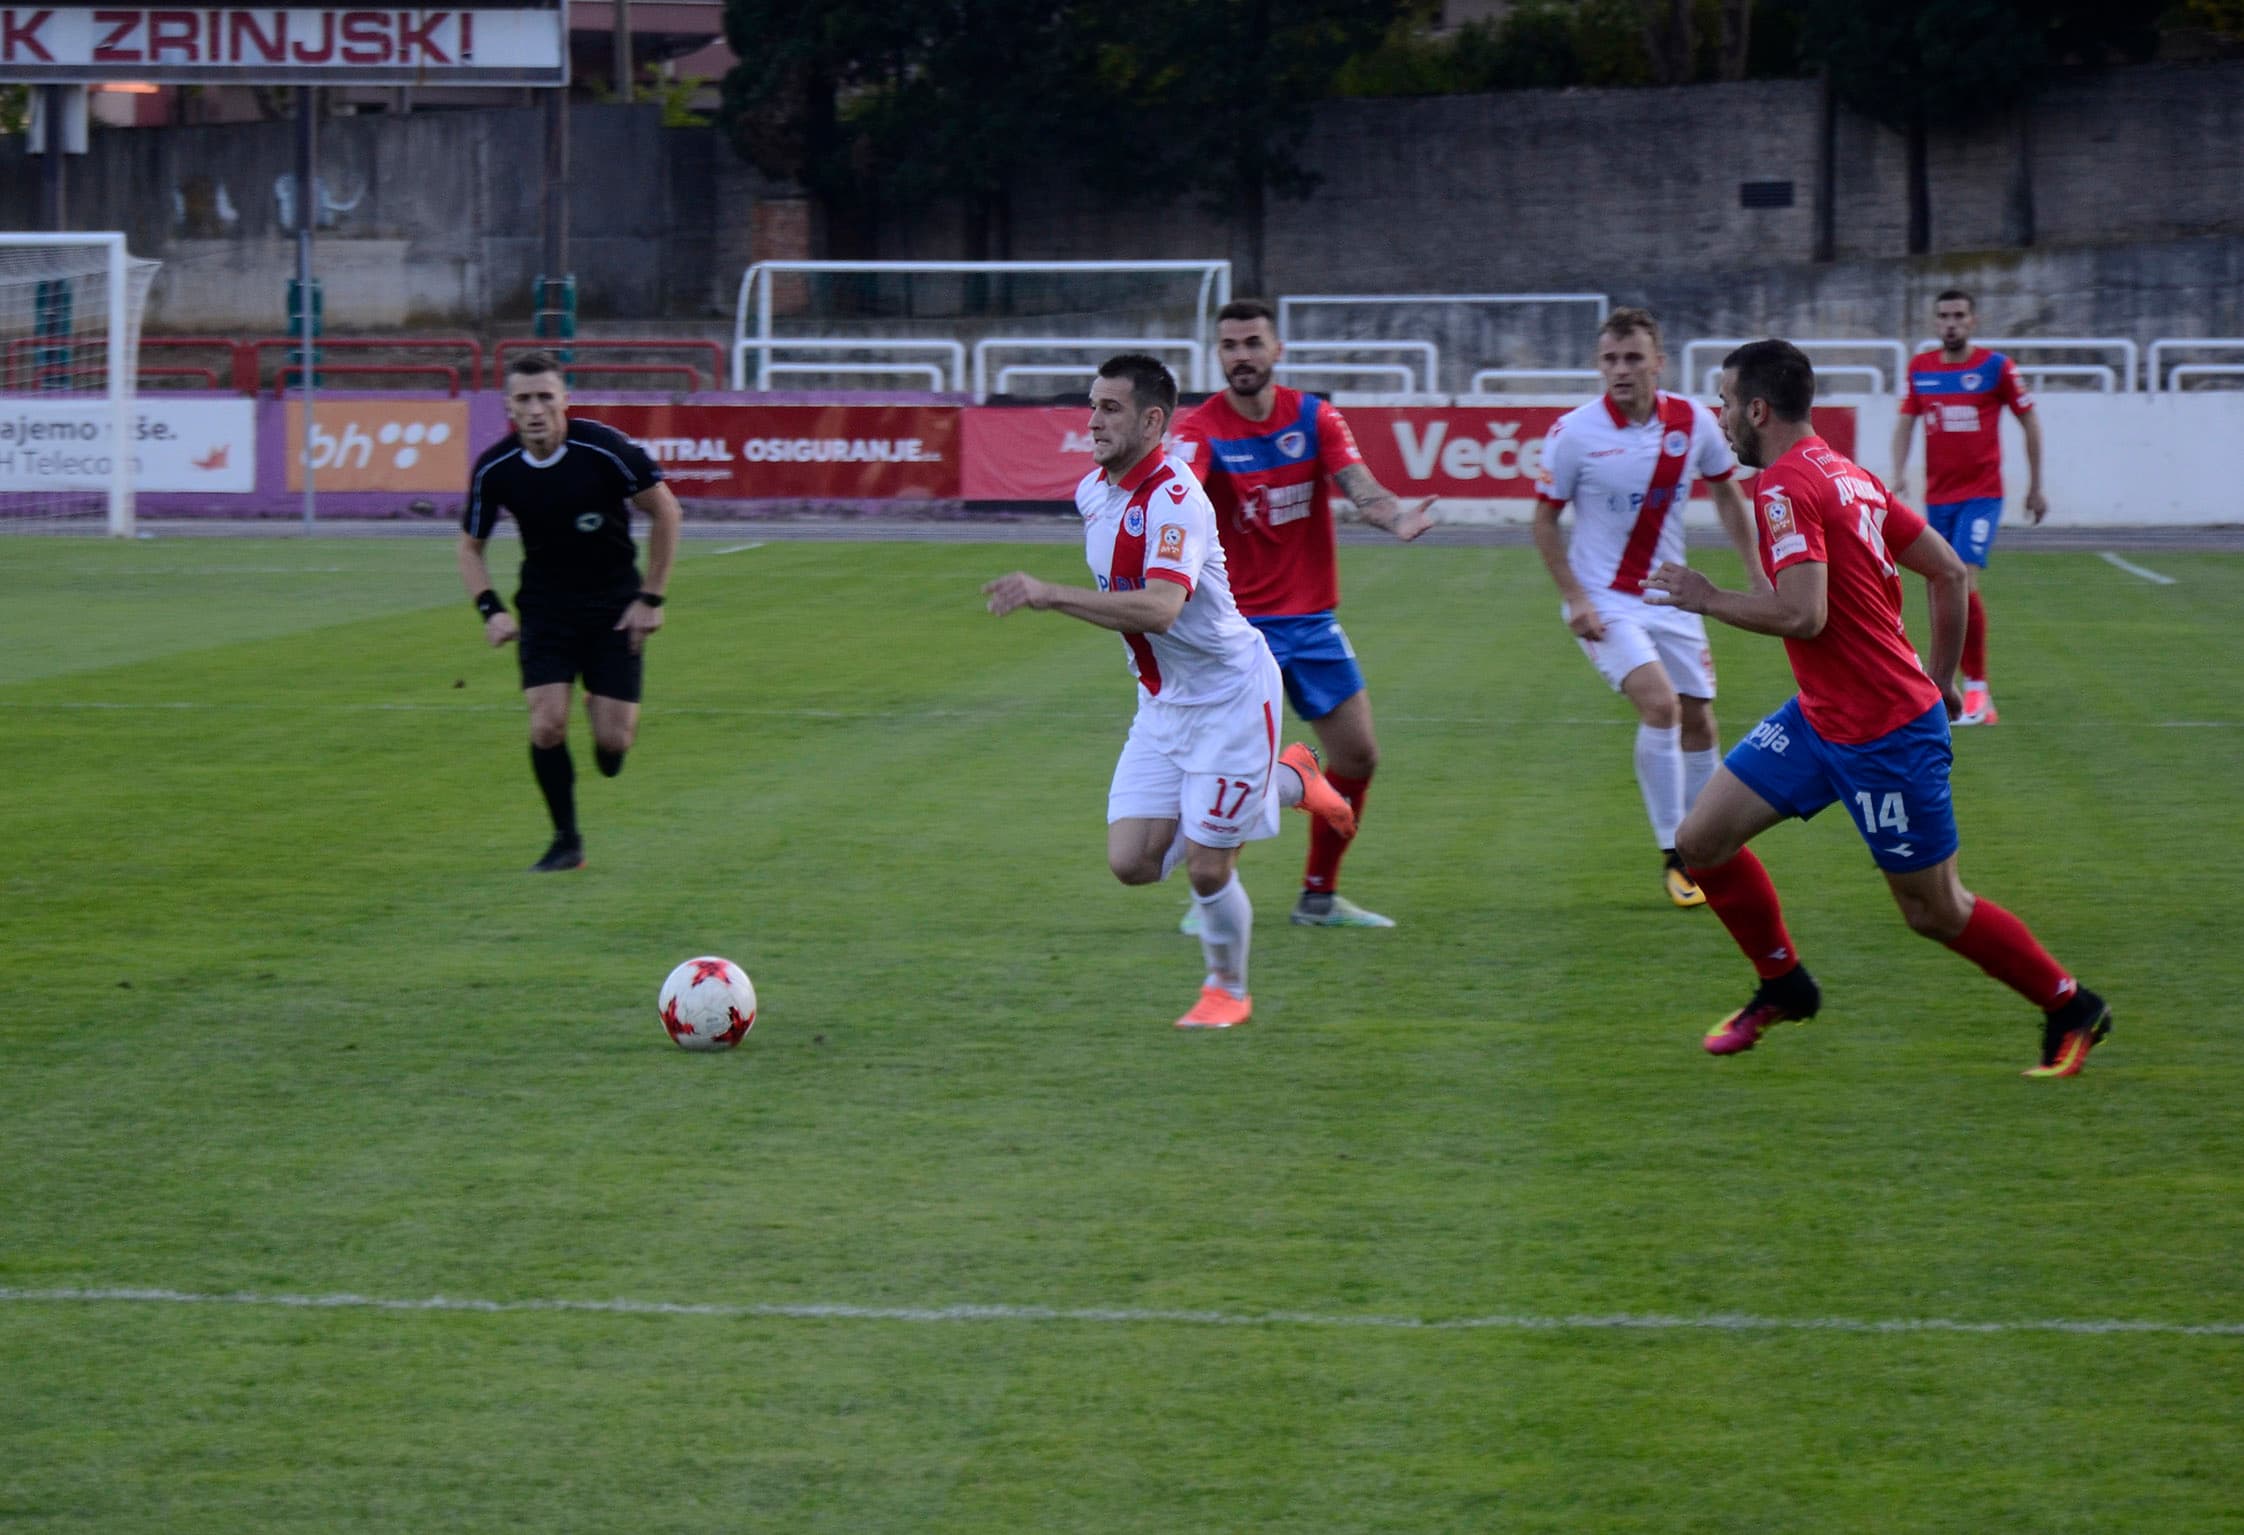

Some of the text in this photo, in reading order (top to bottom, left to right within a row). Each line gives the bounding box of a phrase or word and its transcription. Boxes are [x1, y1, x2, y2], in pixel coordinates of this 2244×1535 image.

[105, 416, 178, 441] še.
[628, 437, 735, 462] NTRAL
[743, 438, 922, 462] OSIGURANJE
[1392, 420, 1547, 480] Veče
[1208, 777, 1252, 819] 17
[1855, 791, 1909, 834] 14
